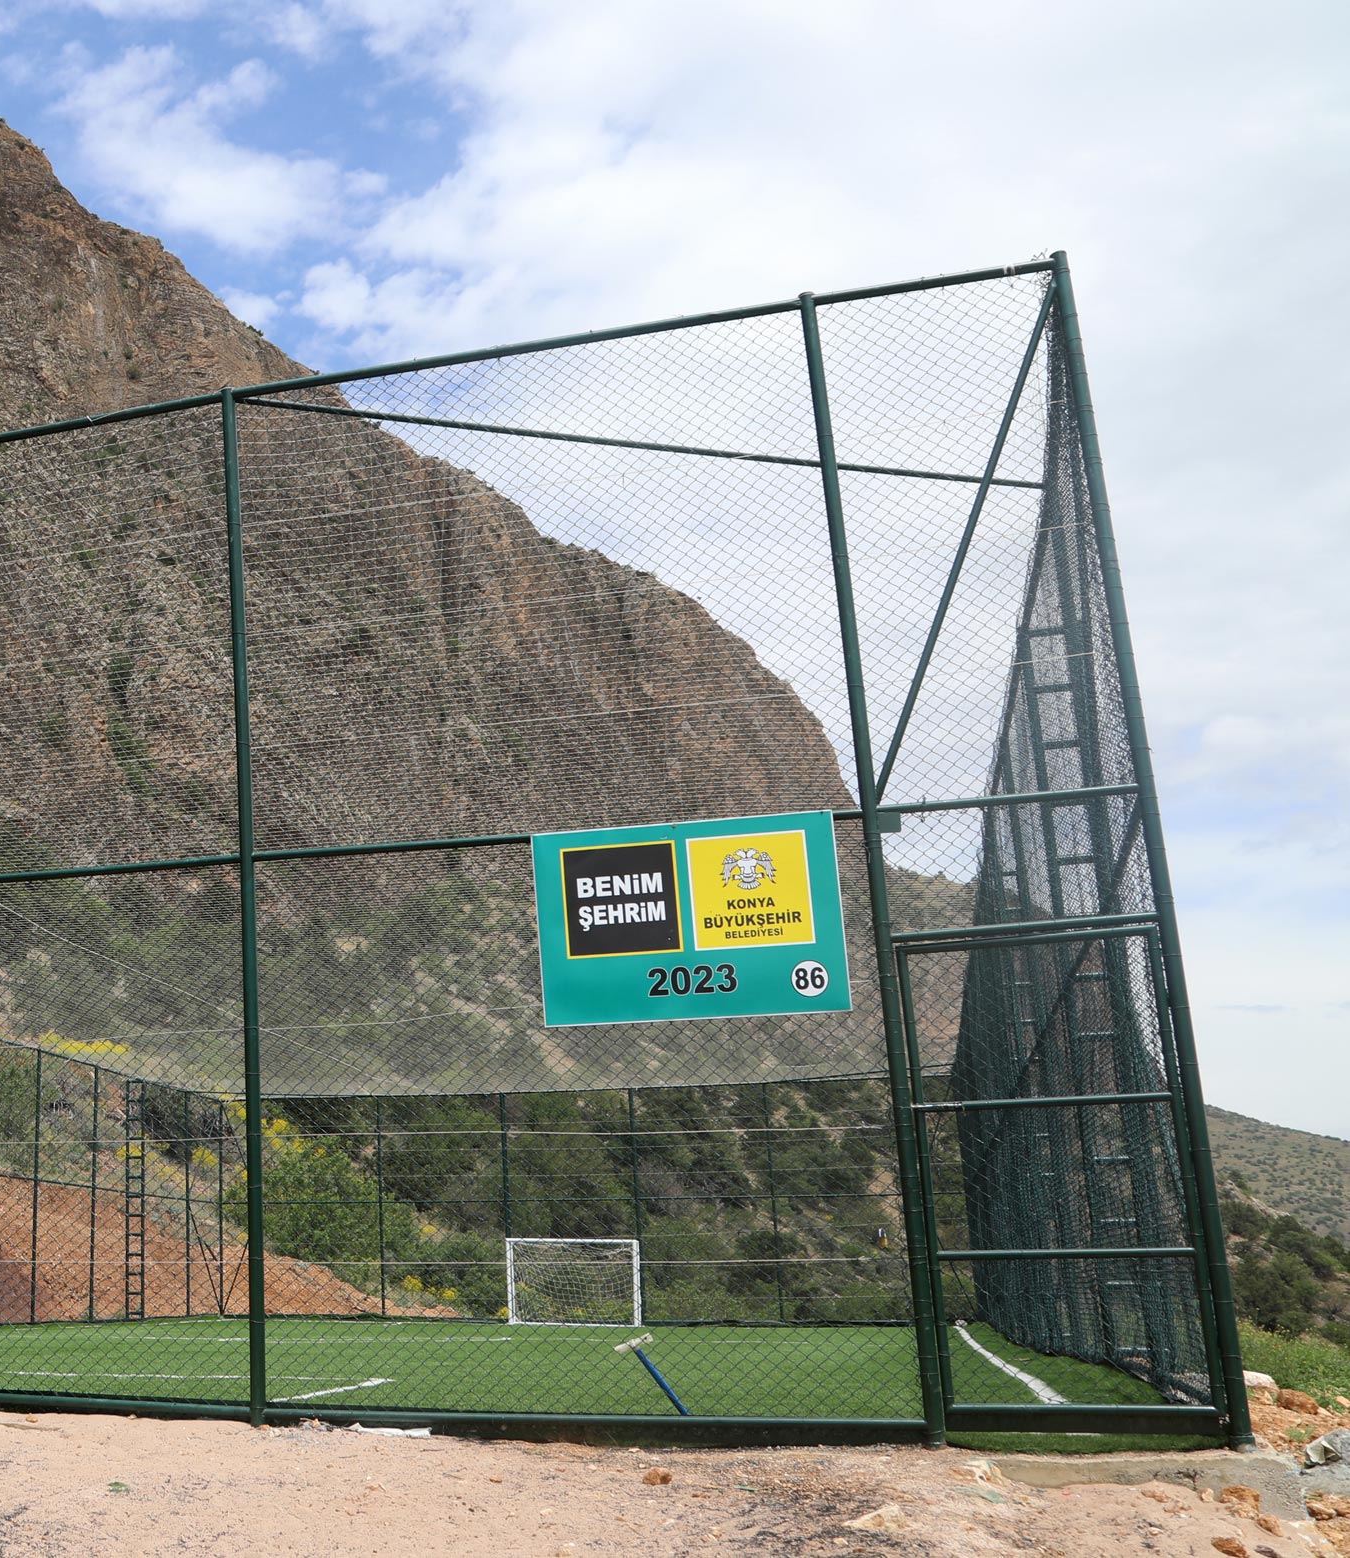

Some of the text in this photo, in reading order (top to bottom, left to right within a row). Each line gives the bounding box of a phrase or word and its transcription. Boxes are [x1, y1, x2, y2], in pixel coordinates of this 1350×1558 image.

[726, 897, 776, 910] KONYA
[704, 909, 802, 930] BÜYÜKŞEHİR
[724, 927, 784, 940] BELEDİYESİ
[647, 963, 738, 997] 2023
[795, 967, 826, 990] 86
